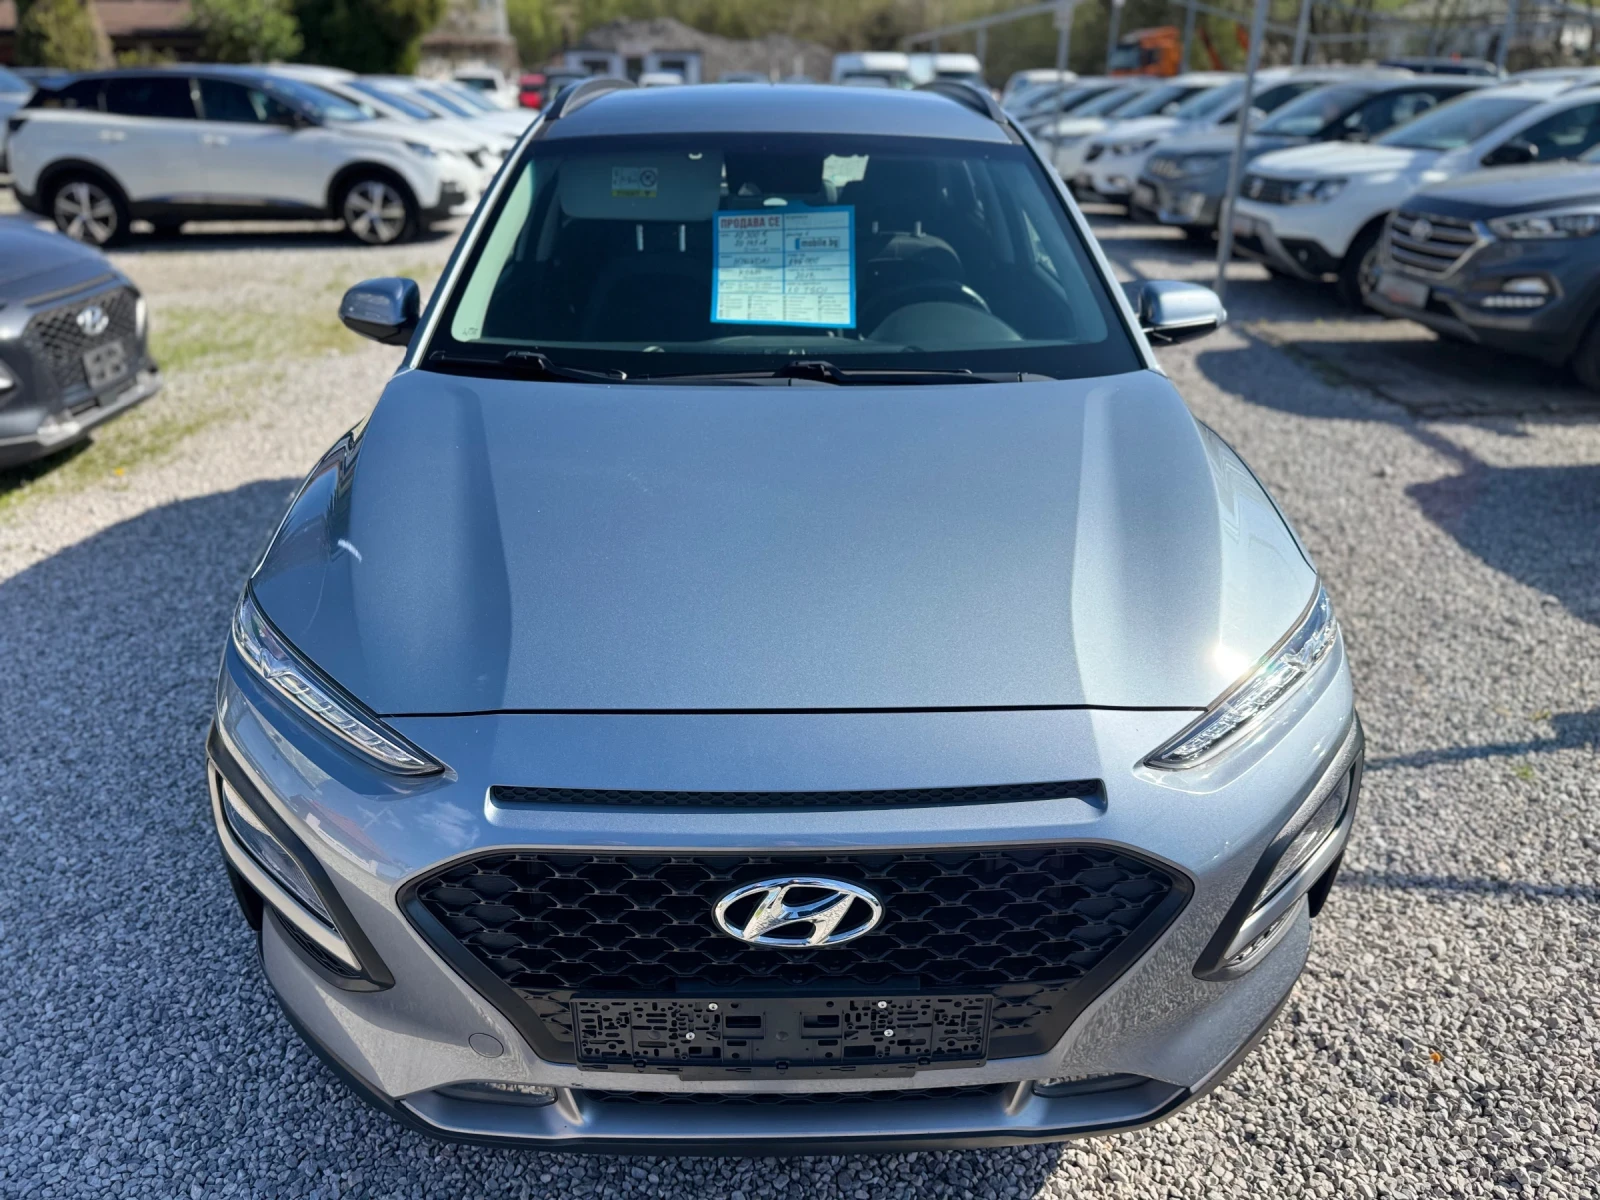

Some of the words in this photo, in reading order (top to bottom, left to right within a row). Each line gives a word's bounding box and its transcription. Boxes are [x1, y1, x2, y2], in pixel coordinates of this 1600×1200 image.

[720, 217, 765, 229] ПРОДАВА
[768, 216, 781, 228] СЕ
[801, 237, 839, 248] mobile.bg
